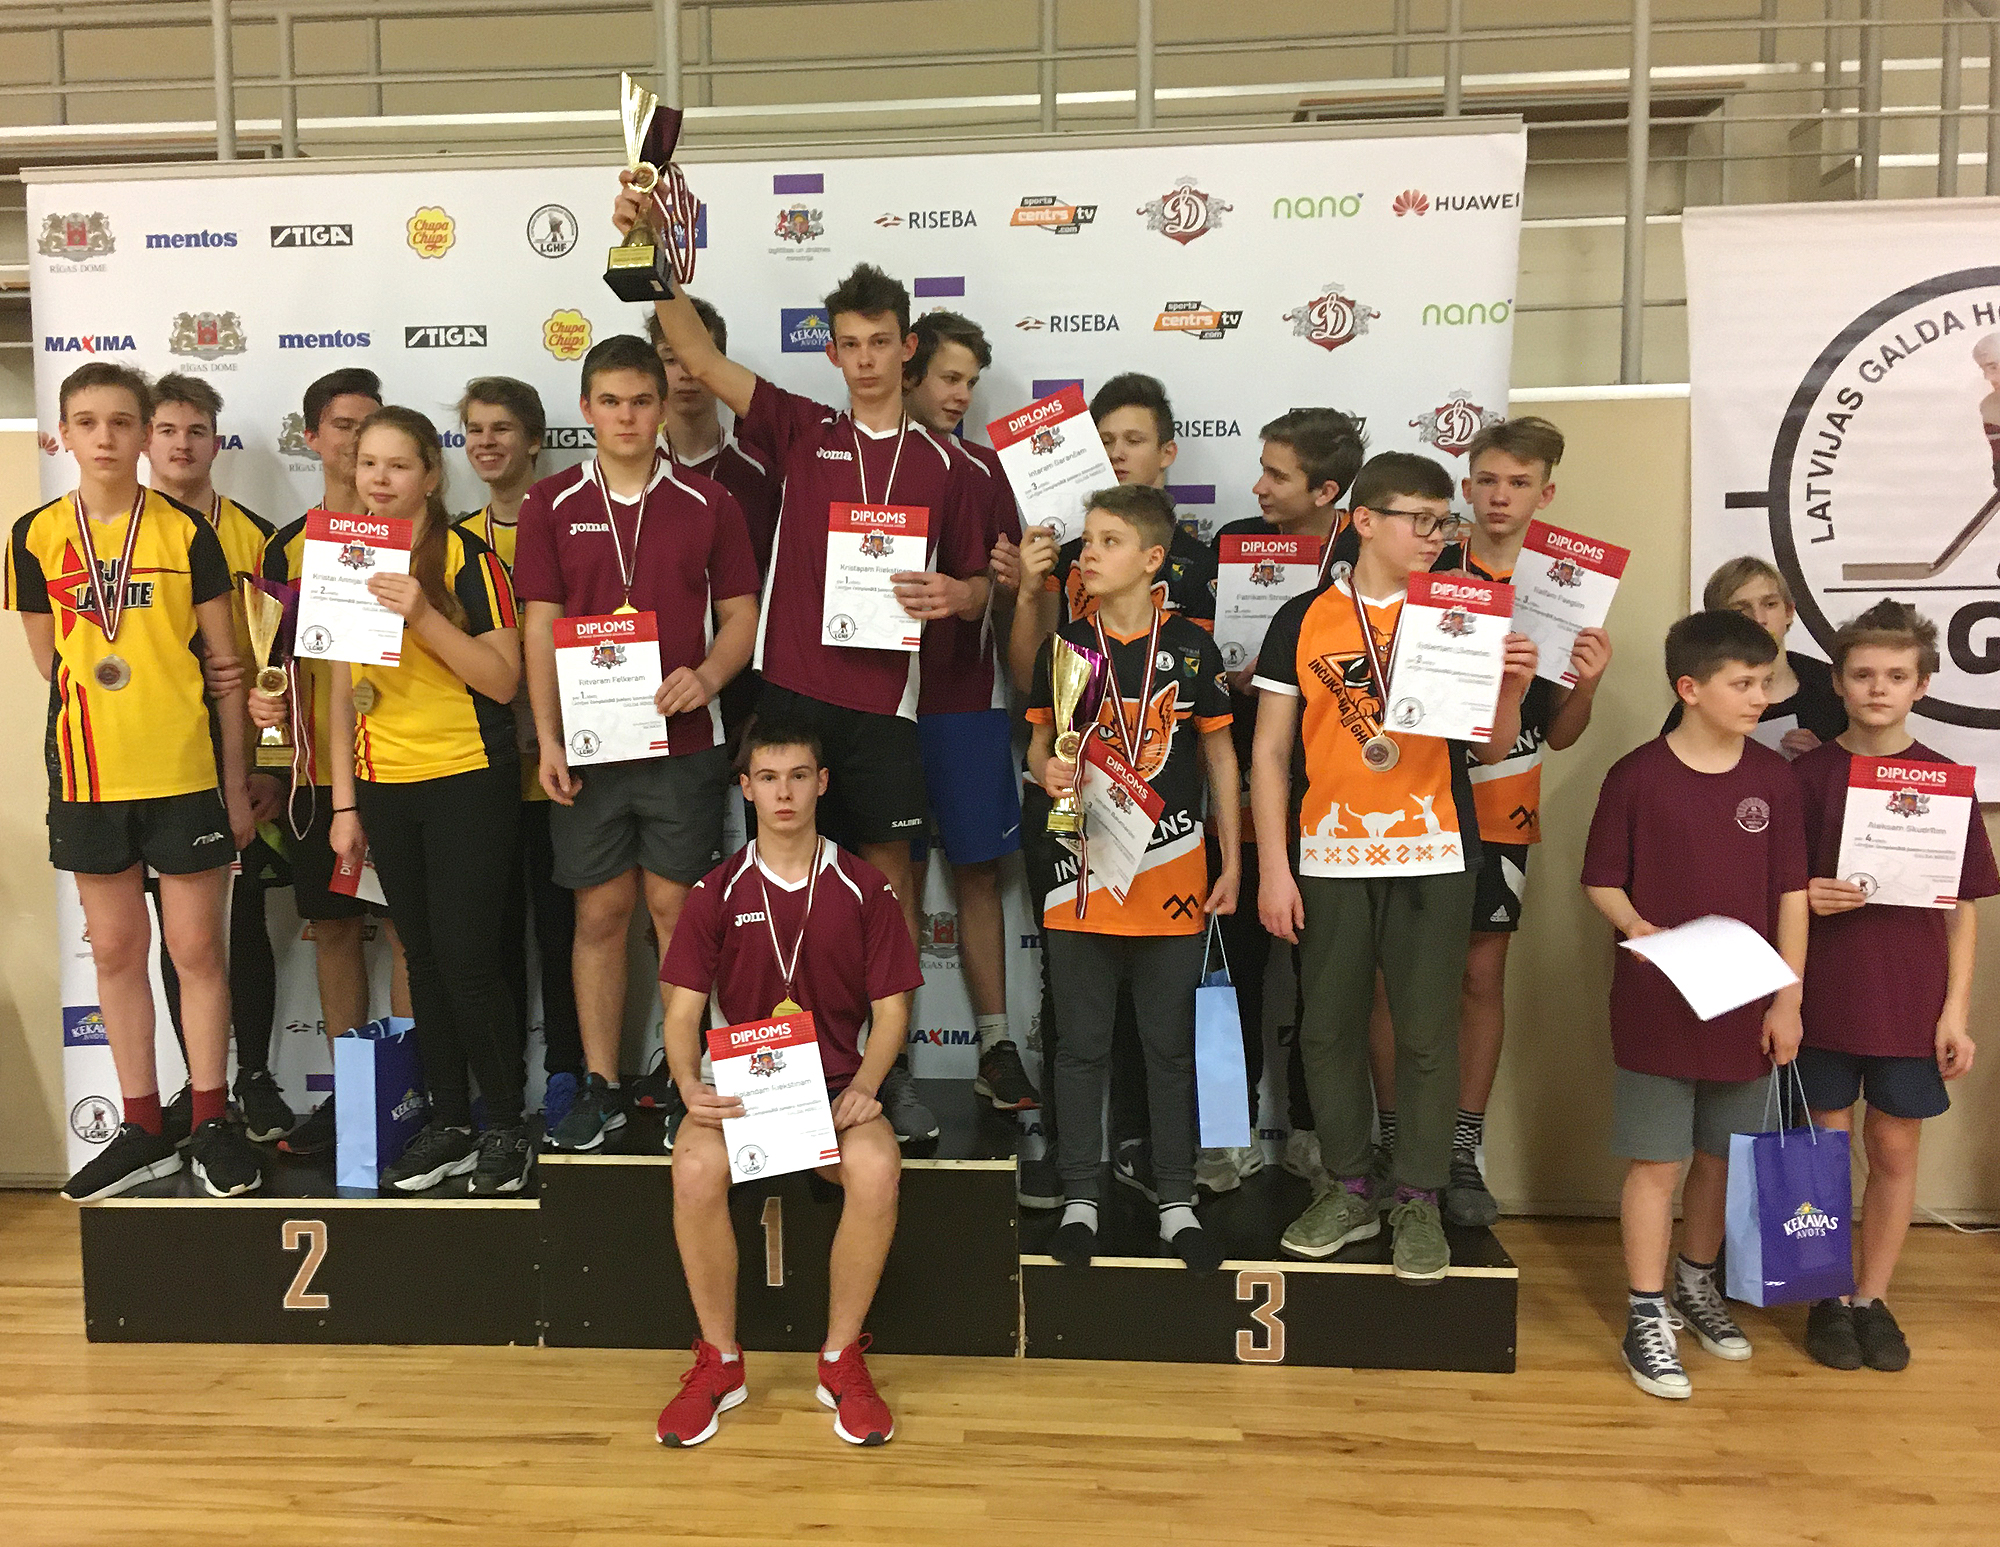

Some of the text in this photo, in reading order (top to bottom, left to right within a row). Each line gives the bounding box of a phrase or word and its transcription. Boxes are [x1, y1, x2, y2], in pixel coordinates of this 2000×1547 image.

[1273, 195, 1361, 219] nano
[1435, 192, 1520, 212] HUAWEI
[909, 210, 978, 229] RISEBA
[1018, 207, 1094, 222] centrs tv
[273, 226, 351, 245] STIGA
[414, 219, 449, 233] Chupa
[145, 228, 238, 249] mentos
[413, 231, 448, 251] Chups
[540, 243, 567, 252] LGHF
[80, 263, 107, 273] DOME
[1161, 312, 1240, 327] centrs tv
[1422, 301, 1510, 326] nano
[550, 321, 586, 335] Chupa
[1050, 314, 1120, 333] RISEBA
[45, 334, 137, 353] MAXIMA
[278, 329, 371, 349] mentos
[407, 326, 485, 347] STIGA
[549, 334, 584, 353] Chups
[789, 329, 833, 343] KEKAVA
[210, 362, 238, 372] DOME
[1008, 399, 1063, 433] DIPLOMS
[1806, 301, 2000, 544] LATVIJAS GALDA H
[1174, 419, 1241, 437] RISEBA
[543, 428, 597, 448] TIGA
[816, 447, 854, 461] Joma
[851, 510, 907, 524] DIPLOMS
[329, 518, 390, 537] DIPLOMS
[569, 522, 610, 535] Joma
[1241, 541, 1298, 553] DIPLOMS
[1547, 532, 1605, 561] DIPLOMS
[1430, 582, 1493, 602] DIPLOMS
[576, 620, 635, 635] DIPLOMS
[1105, 755, 1149, 800] DIPLOMS
[1876, 766, 1947, 783] DIPLOMS
[734, 910, 766, 926] Jom
[730, 1022, 792, 1045] DIPLOMS
[907, 1028, 982, 1047] AXIMA
[1783, 1214, 1839, 1236] KEKAVAS
[1796, 1228, 1826, 1239] AVOTS
[759, 1195, 786, 1289] 1
[281, 1219, 330, 1311] 2
[1235, 1269, 1287, 1364] 3
